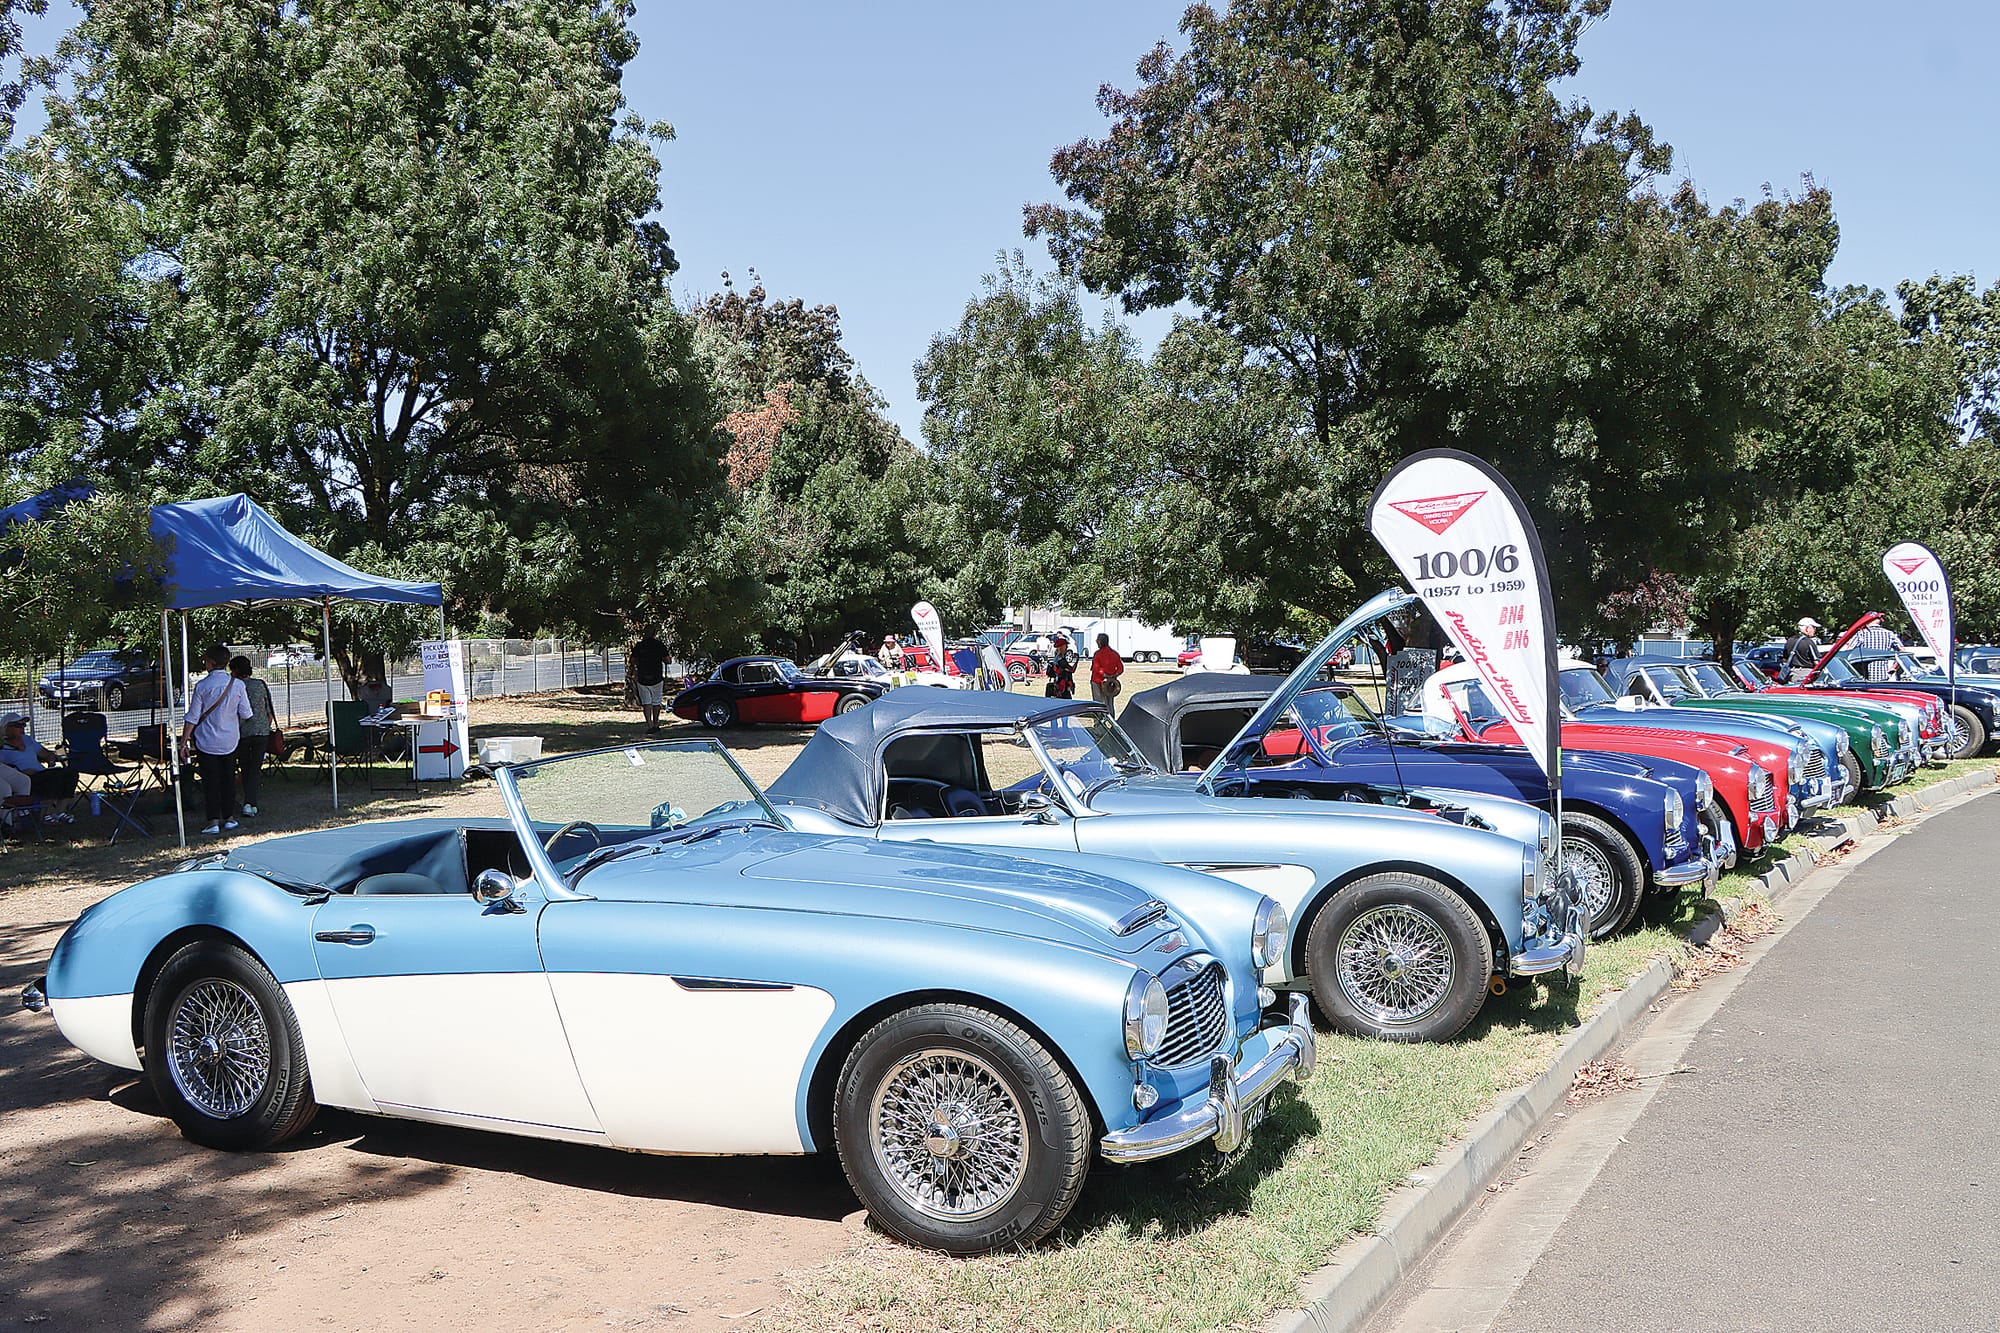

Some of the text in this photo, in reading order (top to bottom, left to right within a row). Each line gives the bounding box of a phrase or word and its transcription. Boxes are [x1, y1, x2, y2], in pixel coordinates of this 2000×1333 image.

[1413, 544, 1520, 580] 100/6
[1423, 579, 1526, 599] (1957 to 1959)
[1896, 580, 1939, 593] 3000
[1499, 604, 1525, 626] BN4
[1399, 677, 1419, 686] 3000
[264, 1069, 287, 1119] POWER
[1029, 1090, 1048, 1126] K715
